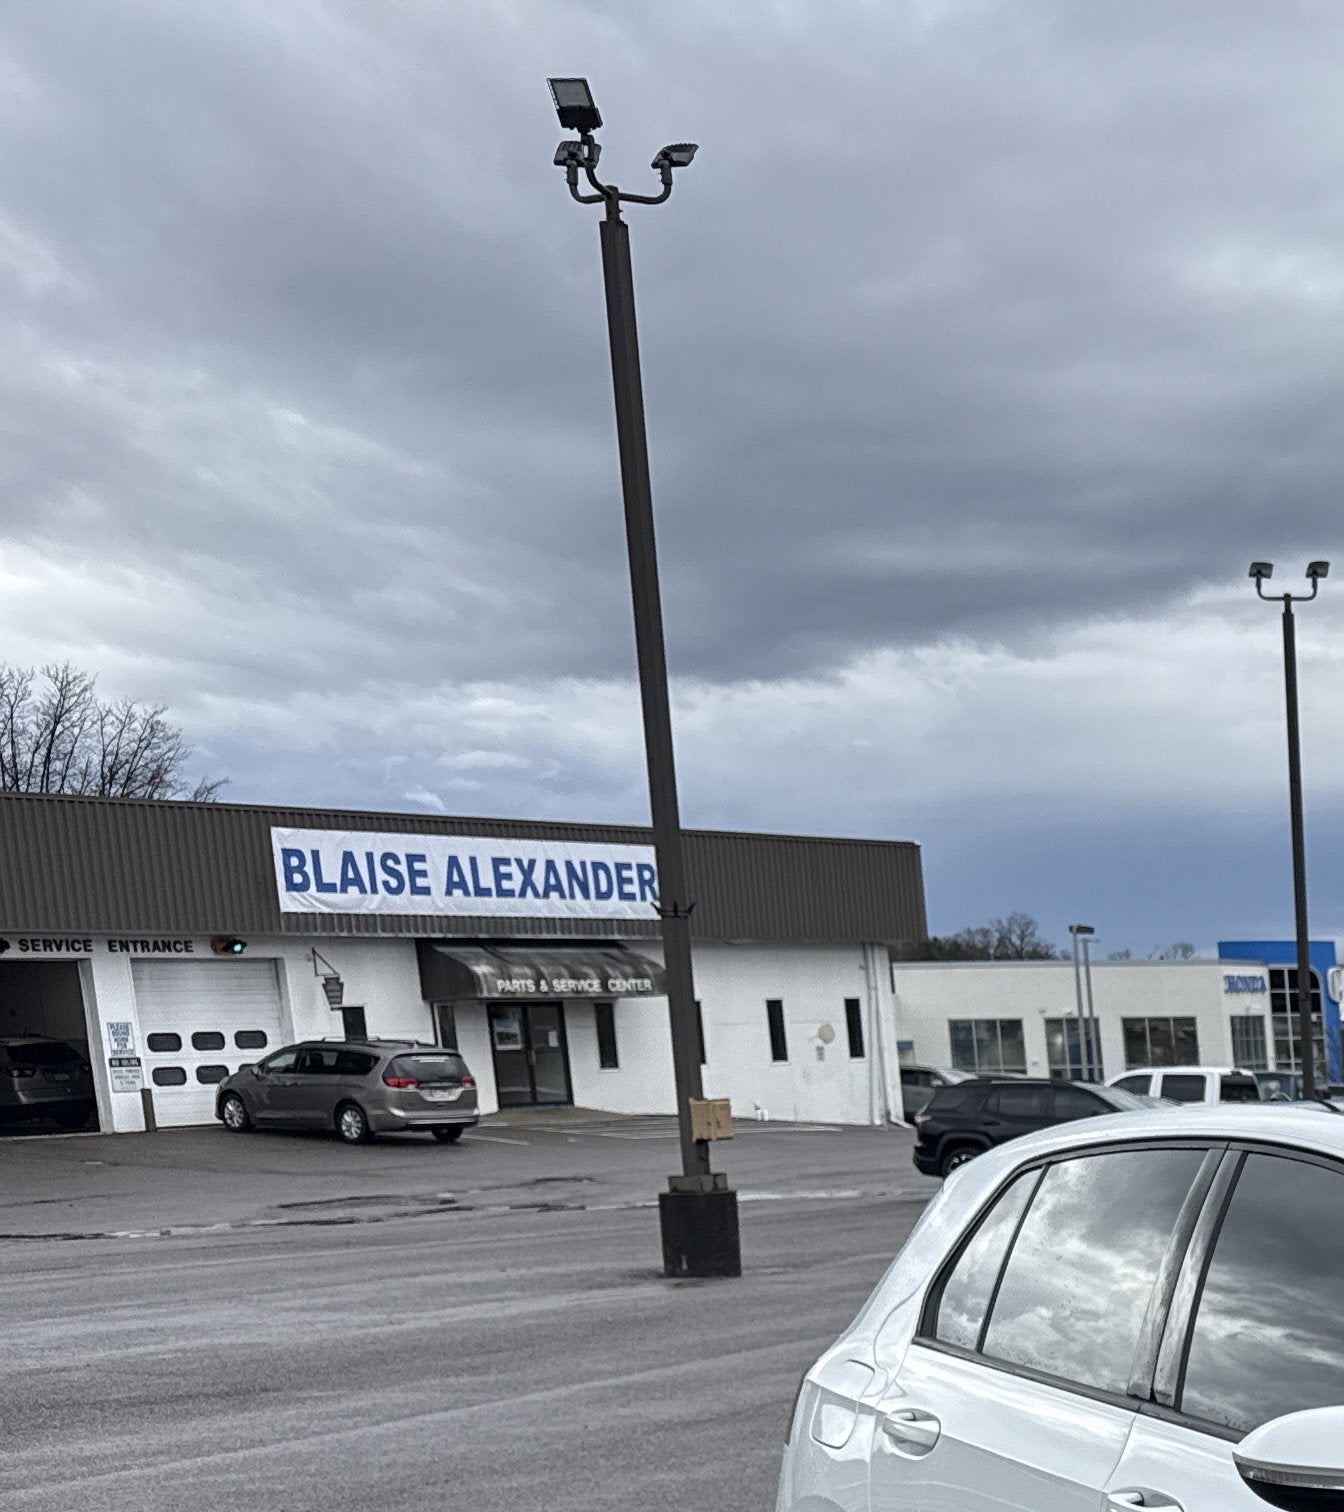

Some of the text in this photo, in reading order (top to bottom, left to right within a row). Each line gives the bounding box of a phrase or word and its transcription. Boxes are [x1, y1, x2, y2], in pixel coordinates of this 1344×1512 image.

[281, 847, 659, 903] BLAISE ALEXANDER
[19, 938, 194, 954] SERVICE ENTRANCE
[497, 979, 653, 992] PARTS & SERVICE CENTER
